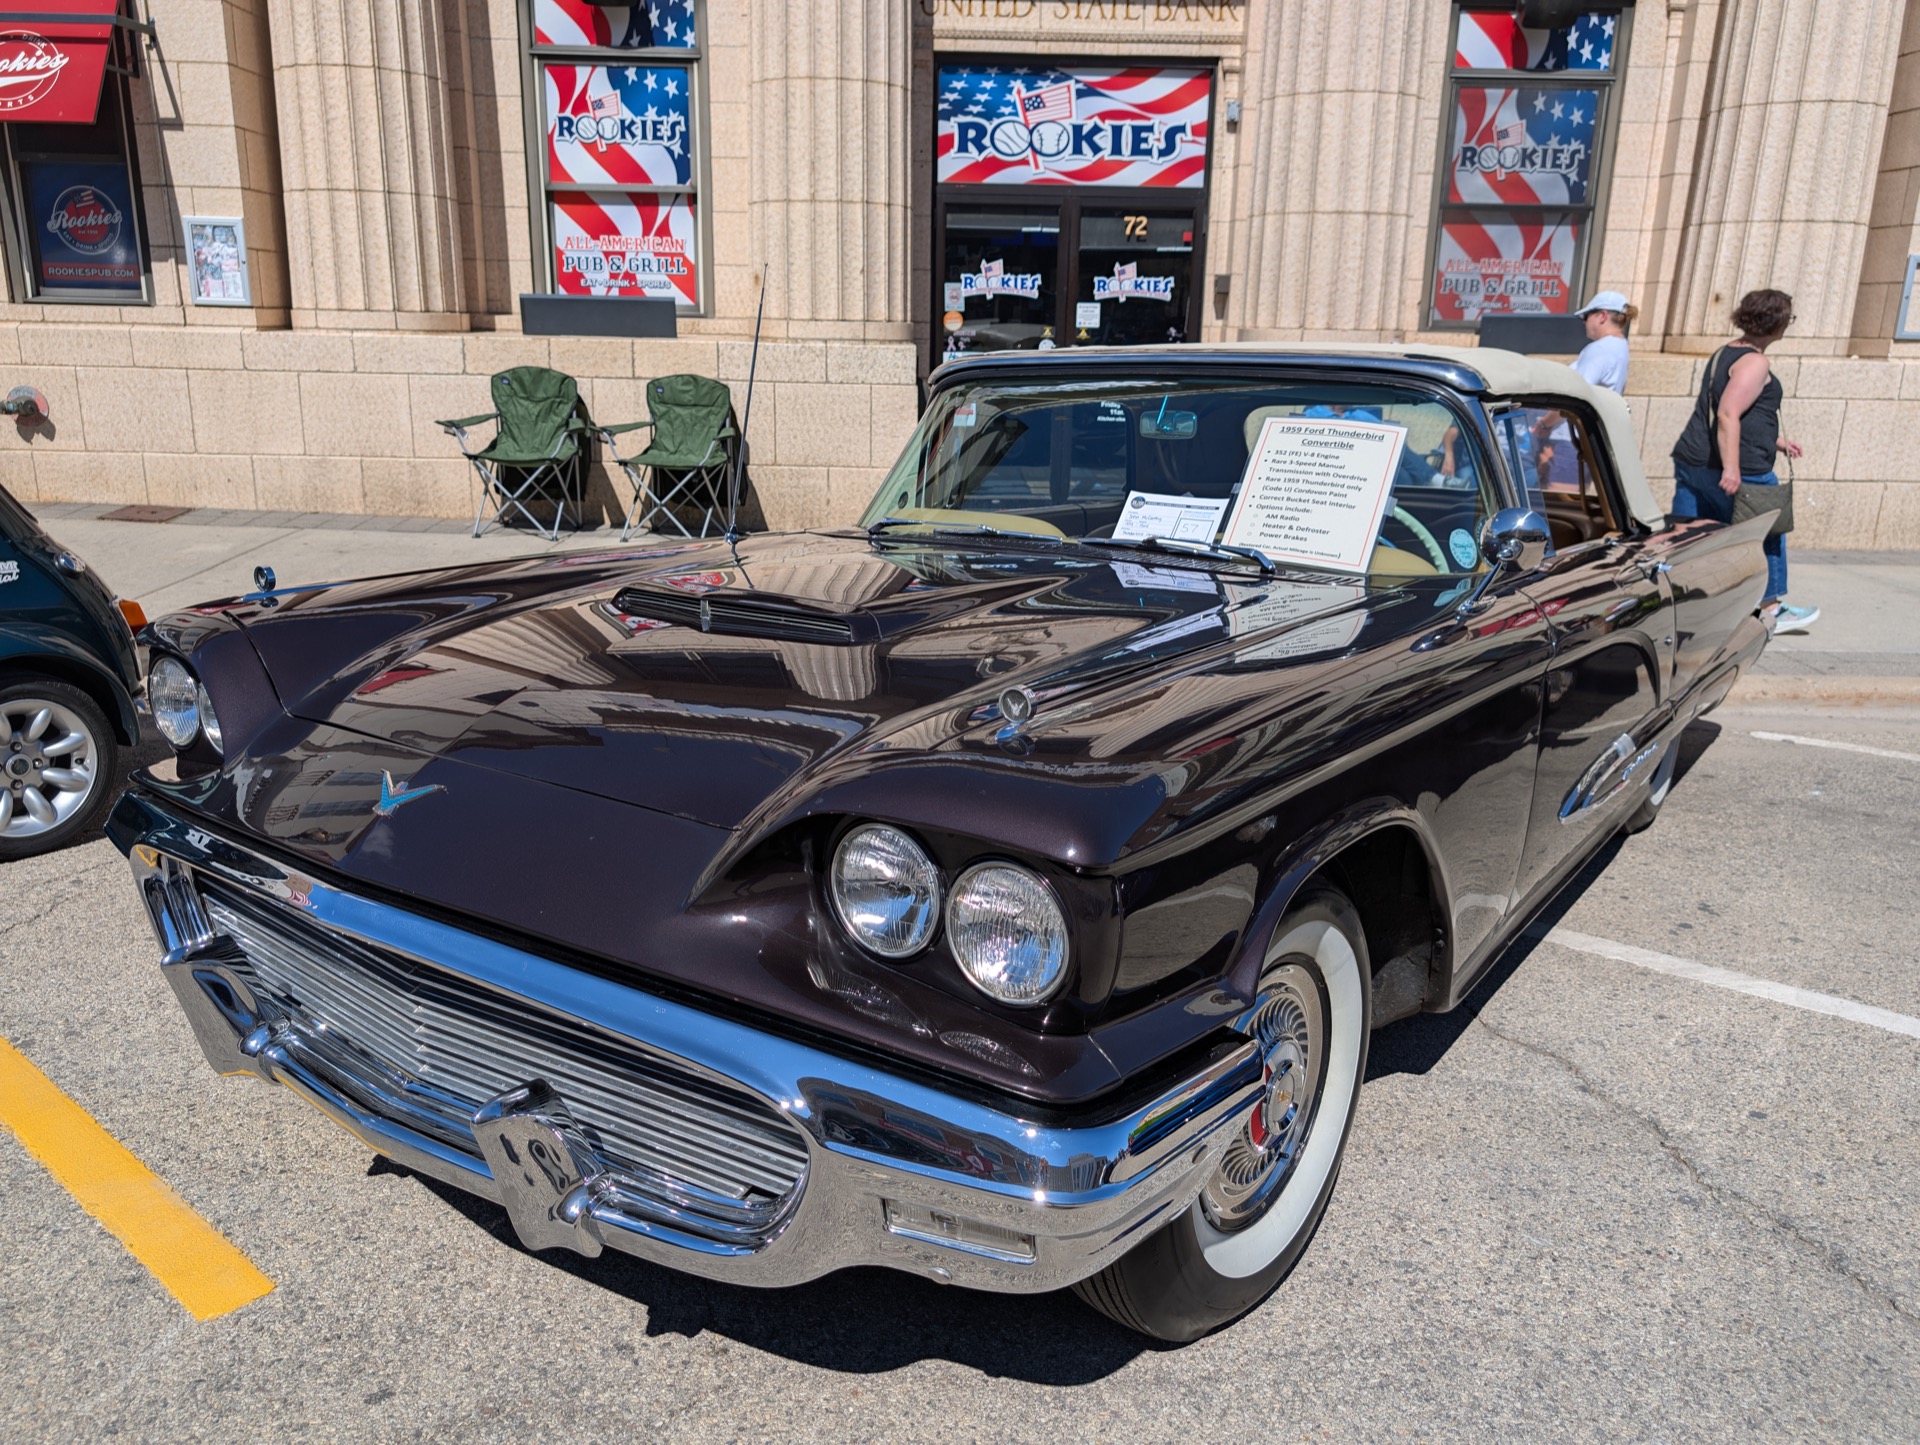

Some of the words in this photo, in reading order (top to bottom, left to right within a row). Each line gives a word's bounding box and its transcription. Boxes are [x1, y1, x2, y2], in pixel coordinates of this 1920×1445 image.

[921, 0, 1034, 17] UNITED
[1053, 0, 1142, 21] STATE
[1155, 0, 1239, 22] BANK
[557, 115, 684, 143] ROOKIES
[953, 118, 1190, 159] ROOKIES
[1459, 145, 1583, 171] ROOKIES
[47, 208, 123, 233] Rookies
[1124, 216, 1148, 236] 72
[564, 235, 686, 252] ALL-AMERICAN
[564, 255, 604, 272] PUB
[609, 256, 624, 273] &
[628, 257, 686, 274] GRILL
[1444, 258, 1563, 275] ALL-AMERICAN
[47, 266, 135, 278] ROOKIESPUB.COM
[581, 278, 598, 288] EAT
[603, 279, 630, 288] DRINK
[637, 280, 672, 290] SPORTS
[963, 276, 1039, 290] ROOKIES
[1096, 279, 1172, 293] ROOKIES
[1441, 278, 1480, 293] PUB
[1485, 279, 1499, 295] &
[1503, 279, 1560, 296] GRILL
[1280, 426, 1302, 434] 1959
[1304, 427, 1325, 435] Ford
[1327, 428, 1385, 441] Thunderbird
[1301, 438, 1355, 450] Convertible
[1316, 453, 1340, 461] Engine
[1289, 459, 1317, 468] 3-Speed
[1318, 462, 1346, 470] Manual
[1269, 467, 1314, 476] Transmission
[1332, 472, 1368, 482] Overdrive
[1262, 484, 1283, 492] (Code
[1294, 487, 1327, 496] Cordovan
[1329, 490, 1348, 499] Paint
[1302, 479, 1345, 489] Thunderbird
[1346, 484, 1362, 492] only
[1256, 503, 1283, 511] Options
[1284, 505, 1313, 514] include:
[1286, 496, 1310, 504] Bucket
[1329, 500, 1356, 510] Interior
[1280, 514, 1300, 522] Radio
[1180, 523, 1199, 533] 57
[1262, 522, 1287, 530] Heater
[1296, 525, 1330, 535] Defroster
[1258, 531, 1282, 539] Power
[1283, 533, 1308, 542] Brakes
